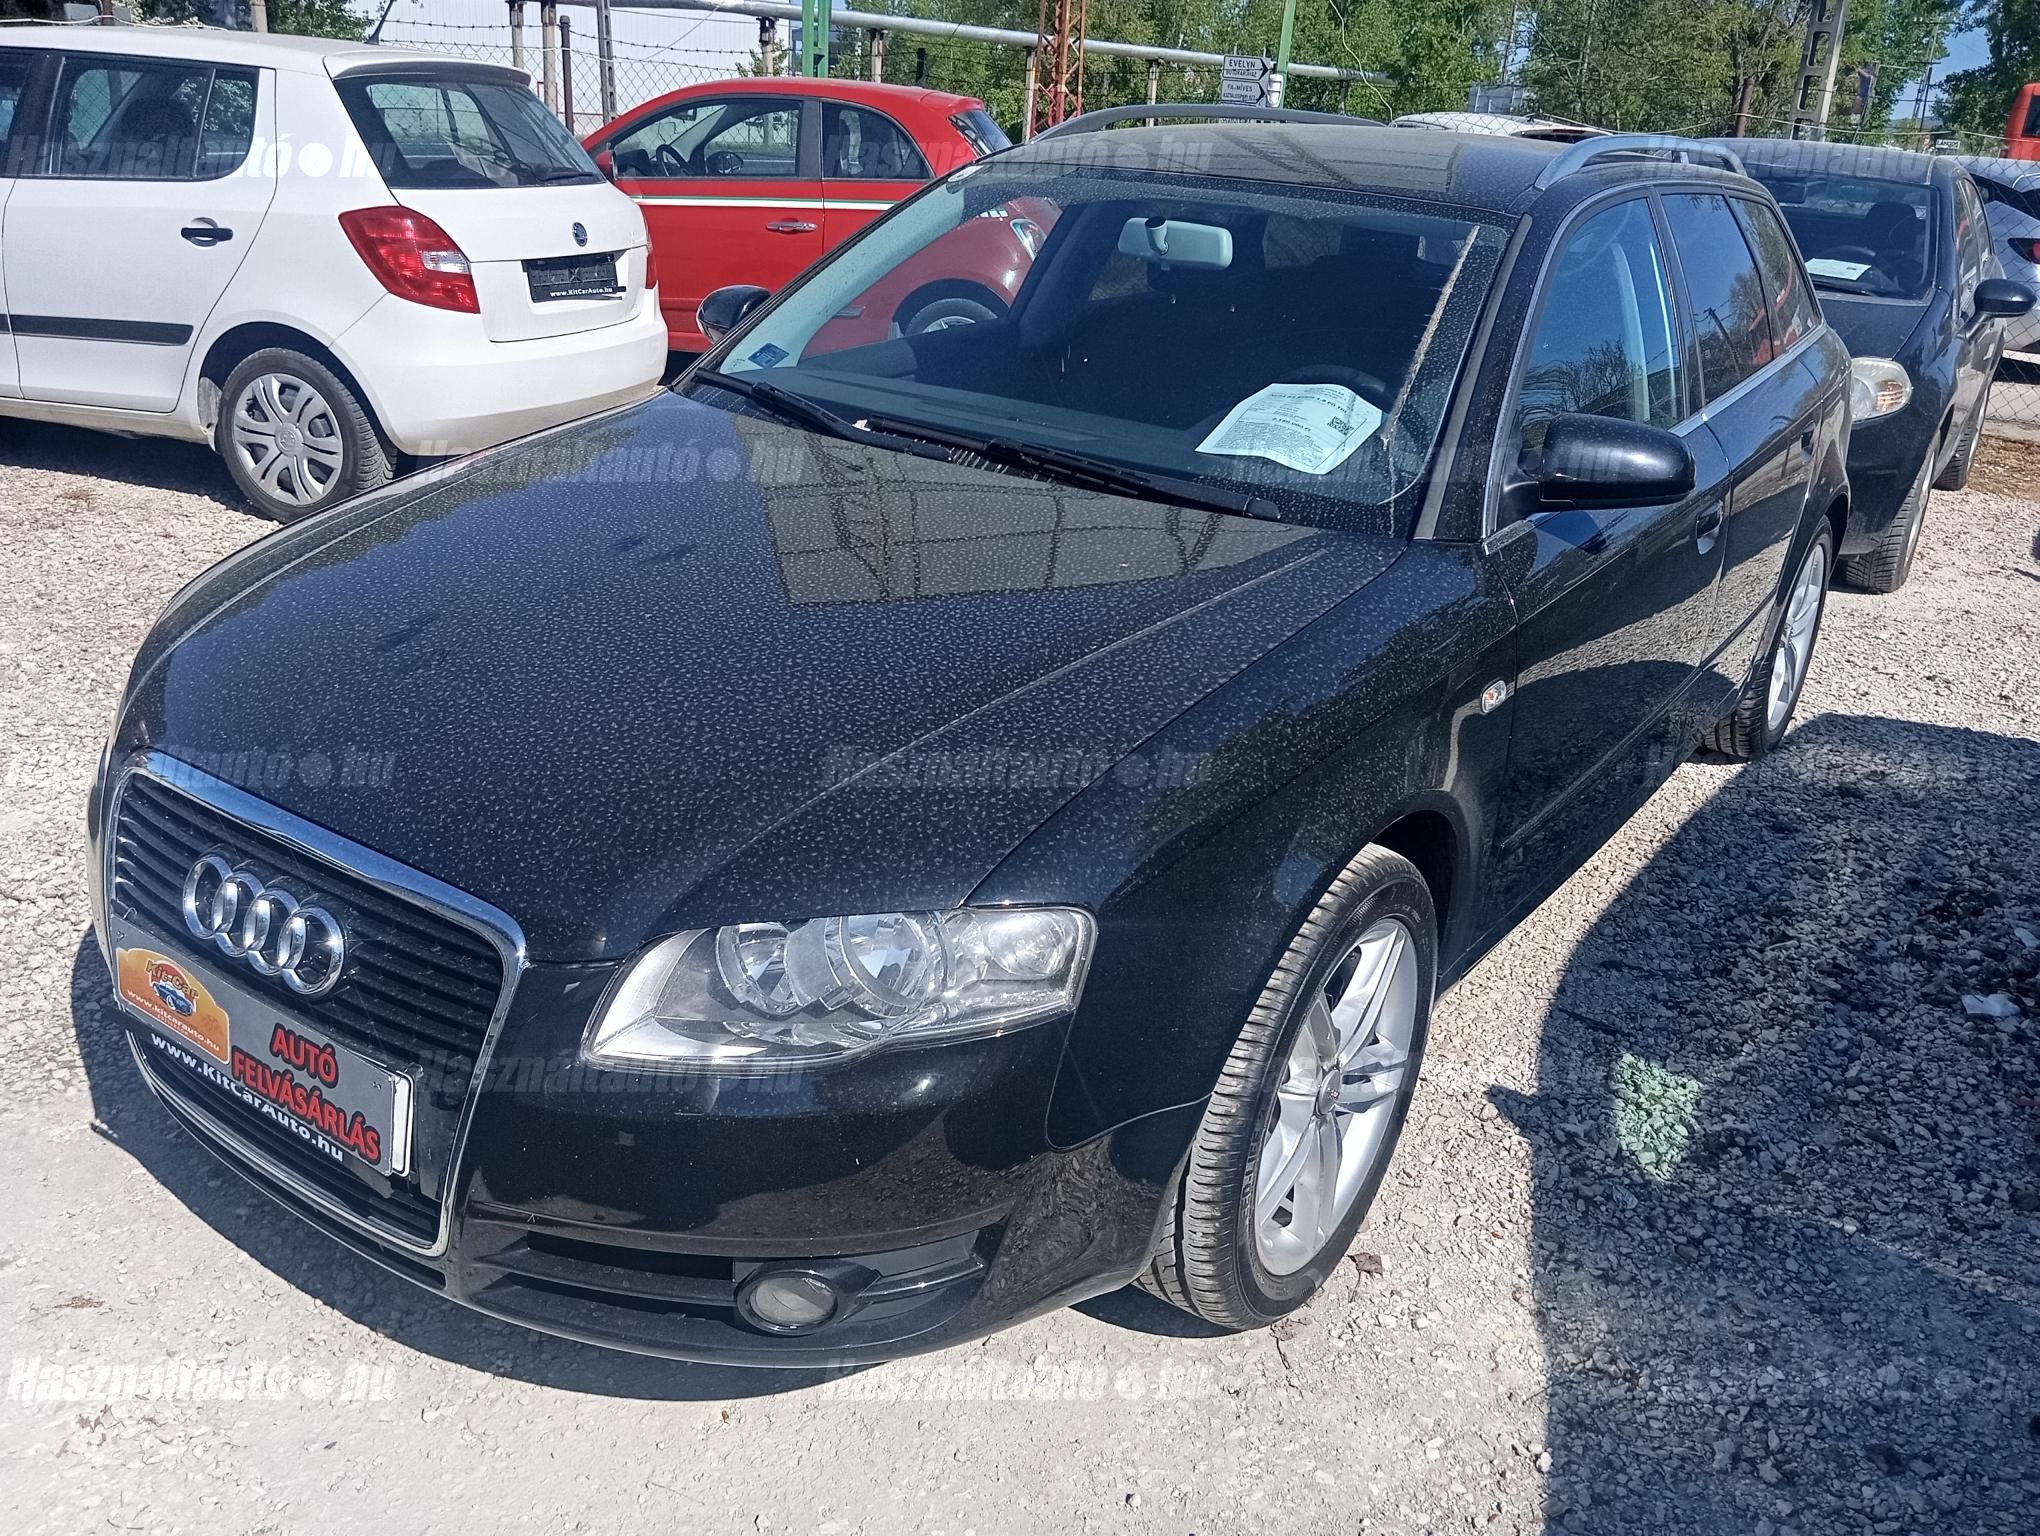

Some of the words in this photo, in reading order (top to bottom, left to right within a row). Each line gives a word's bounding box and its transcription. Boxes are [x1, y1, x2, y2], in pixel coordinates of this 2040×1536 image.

[1228, 59, 1256, 69] EVELYN
[127, 990, 221, 1052] www.kitcarauto.hu
[270, 1024, 338, 1087] AUTÓ
[151, 1033, 344, 1163] www.KitCarAuto.hu
[231, 1046, 381, 1164] FELVÁSÁRLÁS
